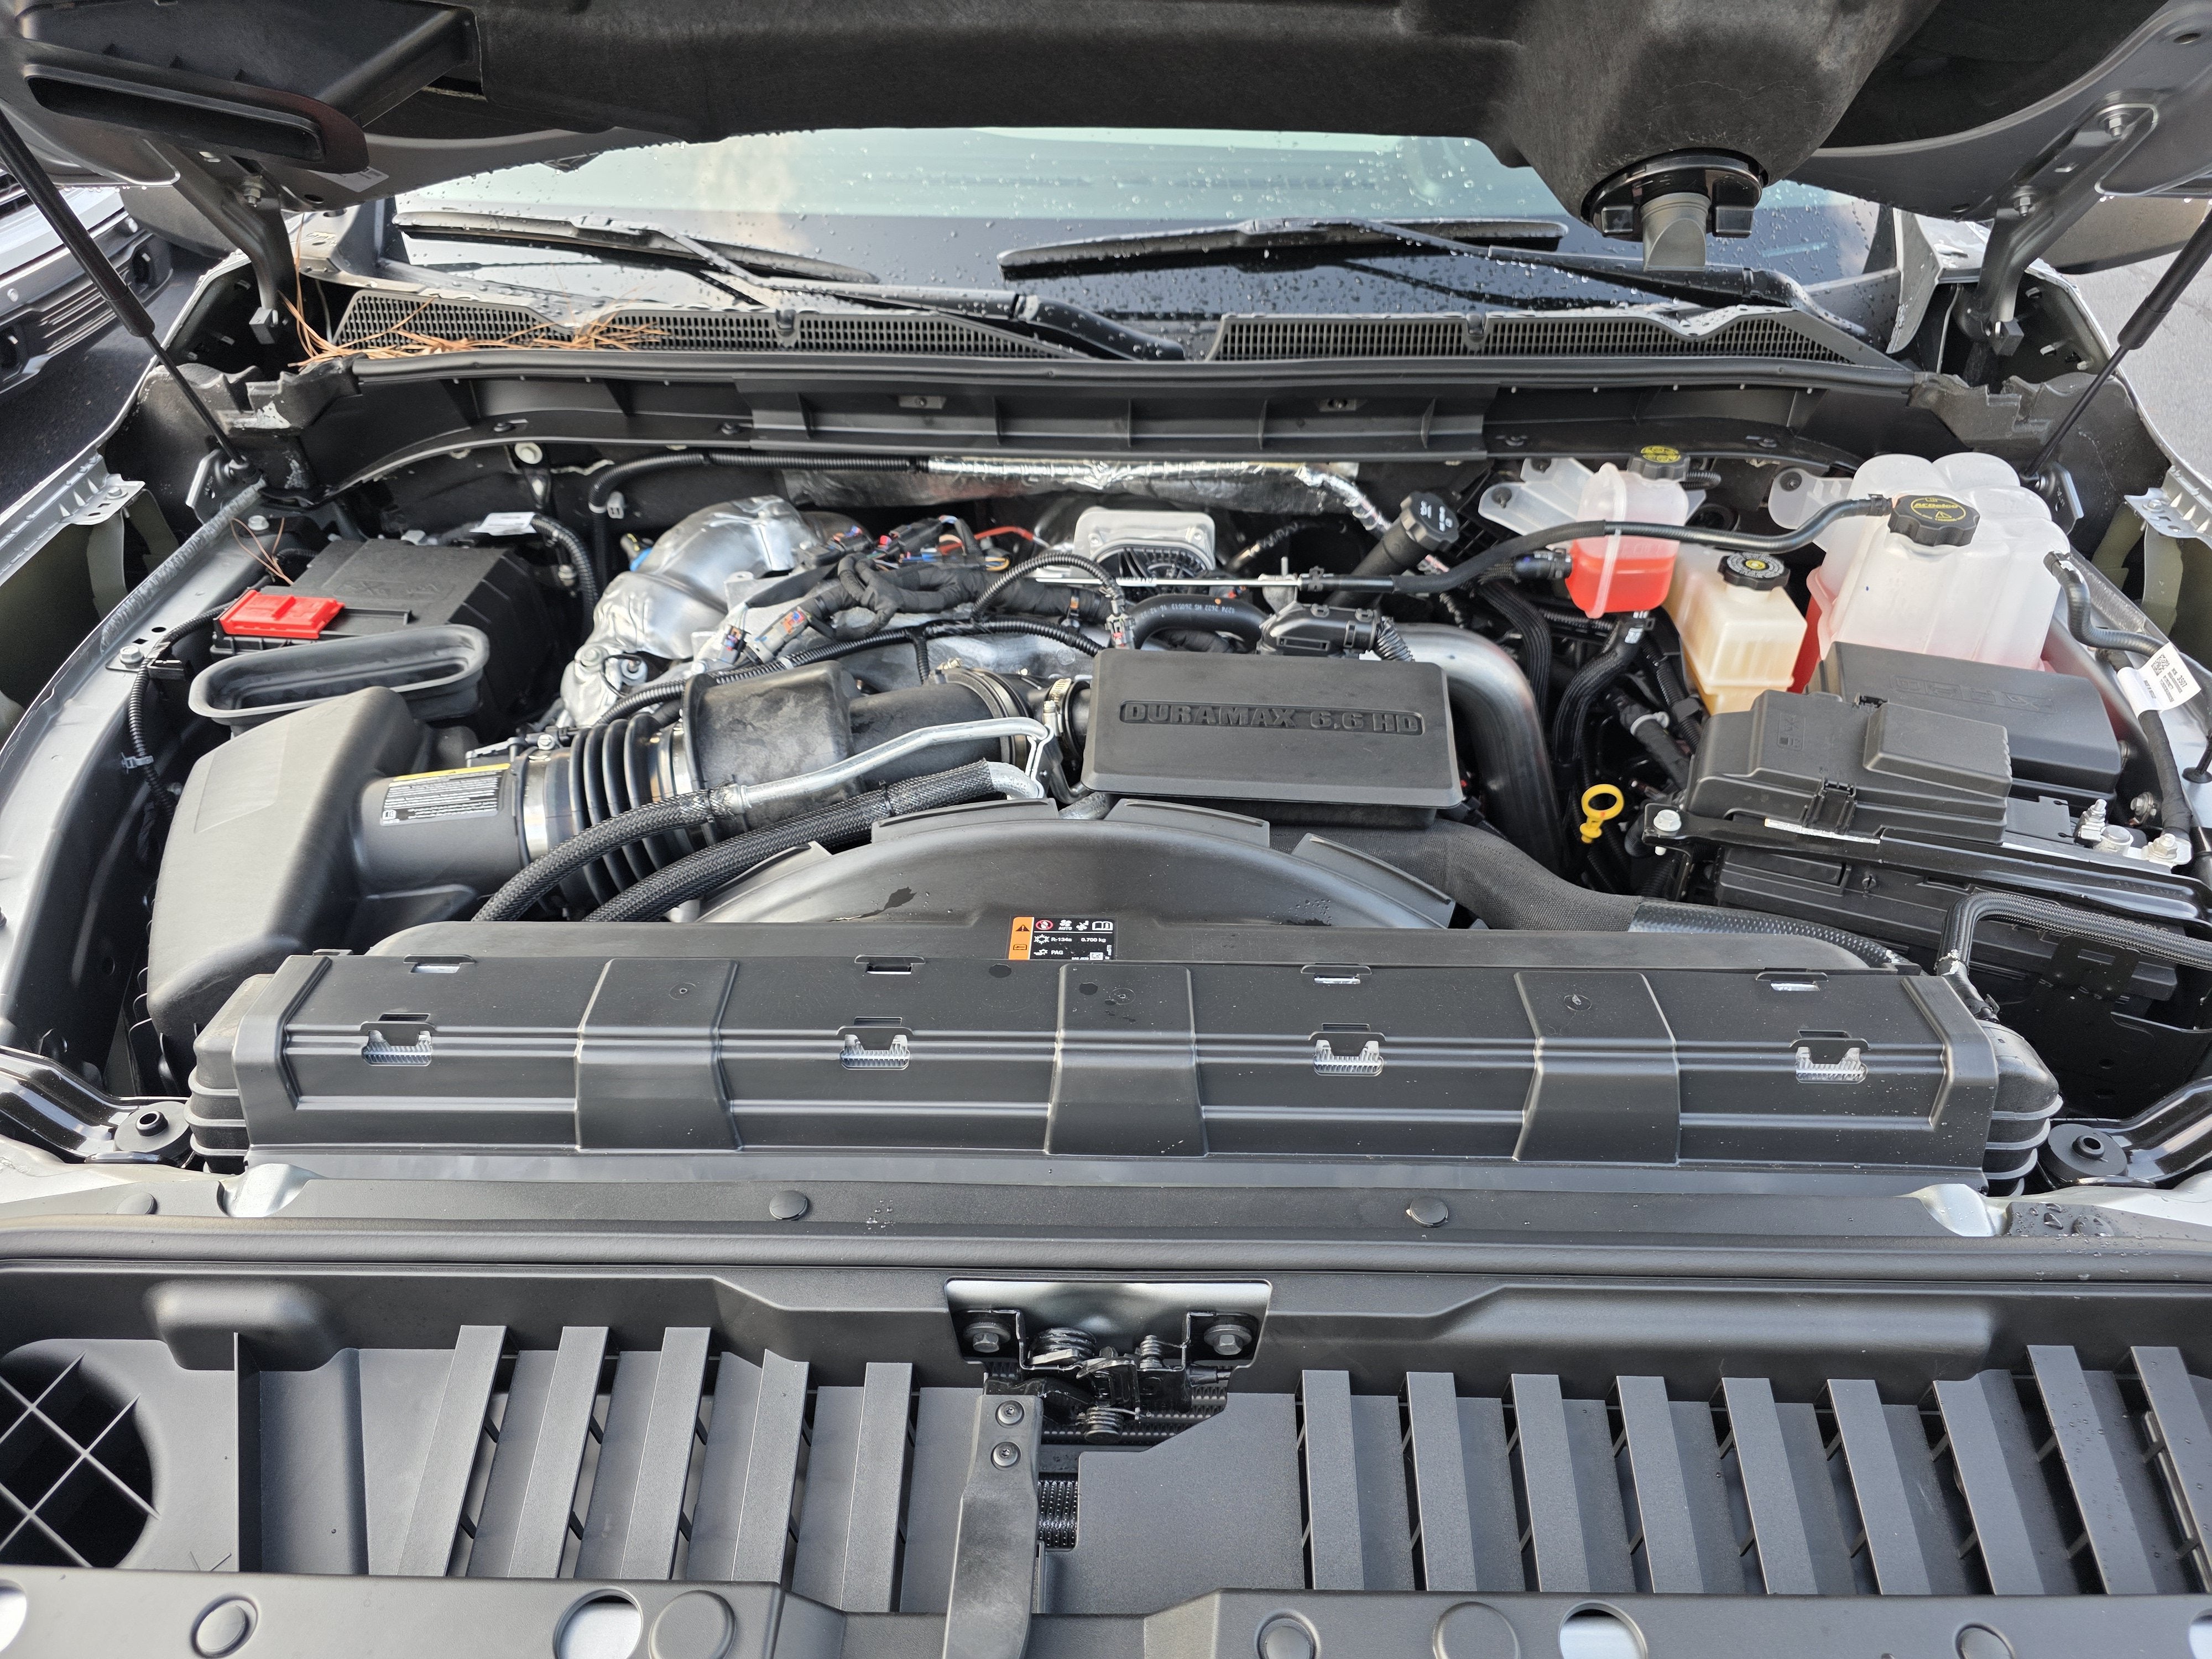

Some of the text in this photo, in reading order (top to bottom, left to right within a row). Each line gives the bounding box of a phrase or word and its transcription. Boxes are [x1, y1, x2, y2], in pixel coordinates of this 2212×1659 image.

[1124, 703, 1419, 734] DURAMAX 6.6 HD
